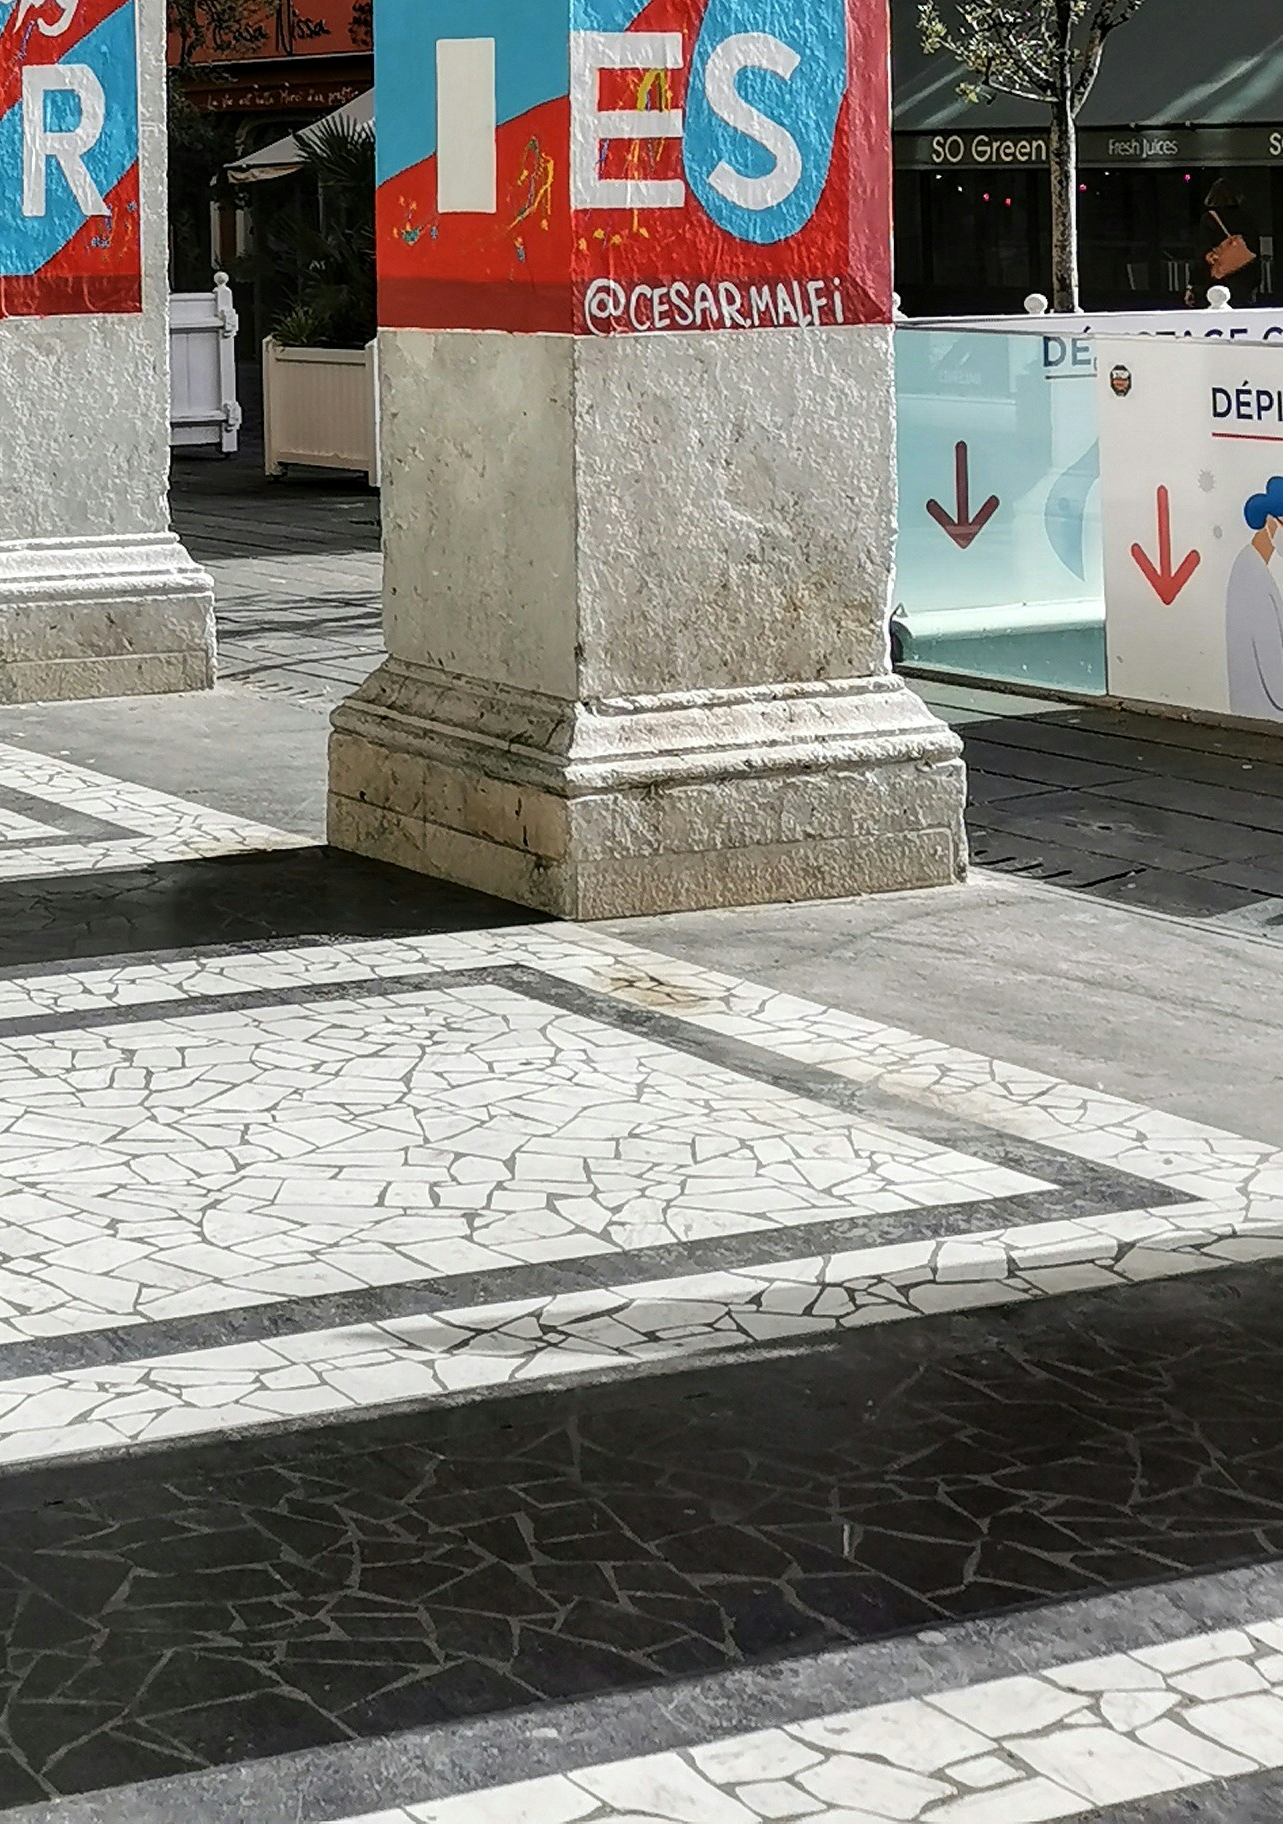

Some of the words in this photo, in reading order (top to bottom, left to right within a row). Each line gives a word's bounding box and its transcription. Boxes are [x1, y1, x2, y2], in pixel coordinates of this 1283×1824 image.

[931, 134, 965, 163] SO
[971, 133, 1047, 163] Green
[1108, 138, 1140, 155] Fresh
[1141, 138, 1179, 158] Juices
